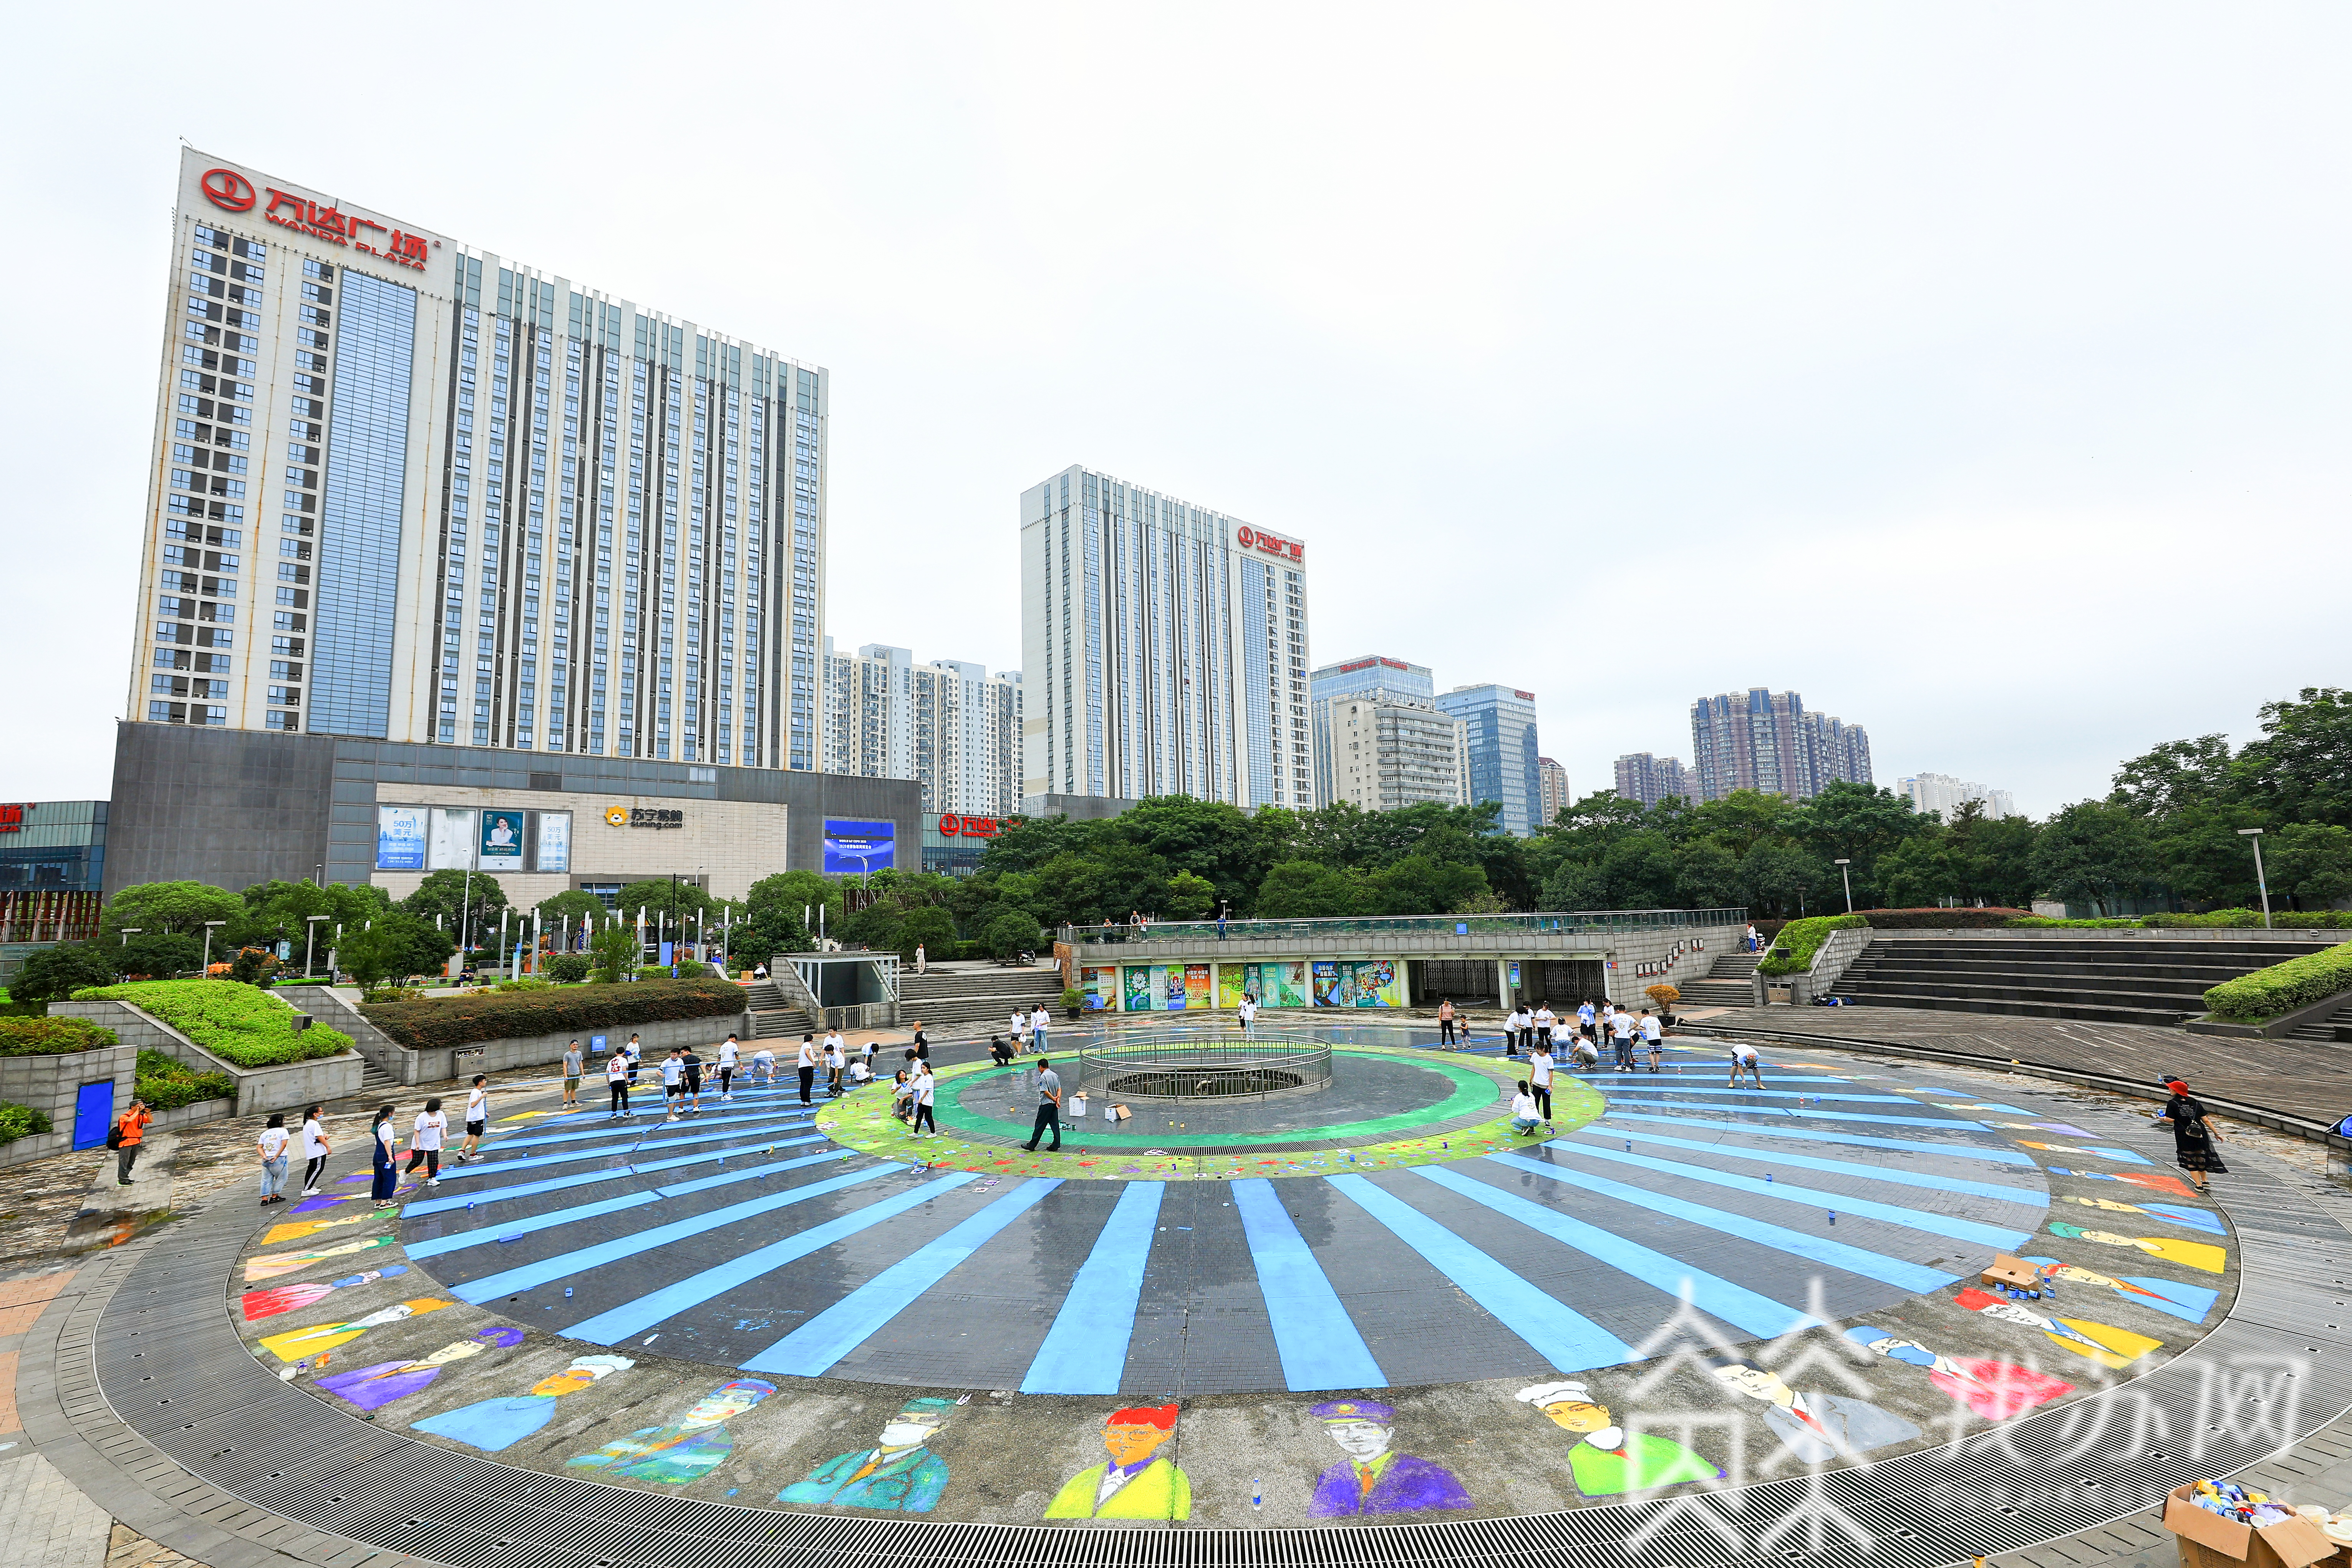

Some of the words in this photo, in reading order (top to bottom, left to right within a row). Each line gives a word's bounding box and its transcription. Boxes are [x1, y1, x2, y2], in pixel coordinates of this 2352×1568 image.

[266, 187, 428, 261] 万达广场
[264, 212, 349, 247] WANDA
[356, 241, 426, 271] PLAZA
[1255, 531, 1301, 557] 万达广场
[1257, 545, 1280, 556] WANDA
[1281, 553, 1302, 563] PLAZA
[1340, 660, 1376, 673] Sheraton
[1381, 658, 1408, 670] Sheraton
[632, 808, 683, 821] 苏宁易购
[631, 821, 682, 830] suning.com
